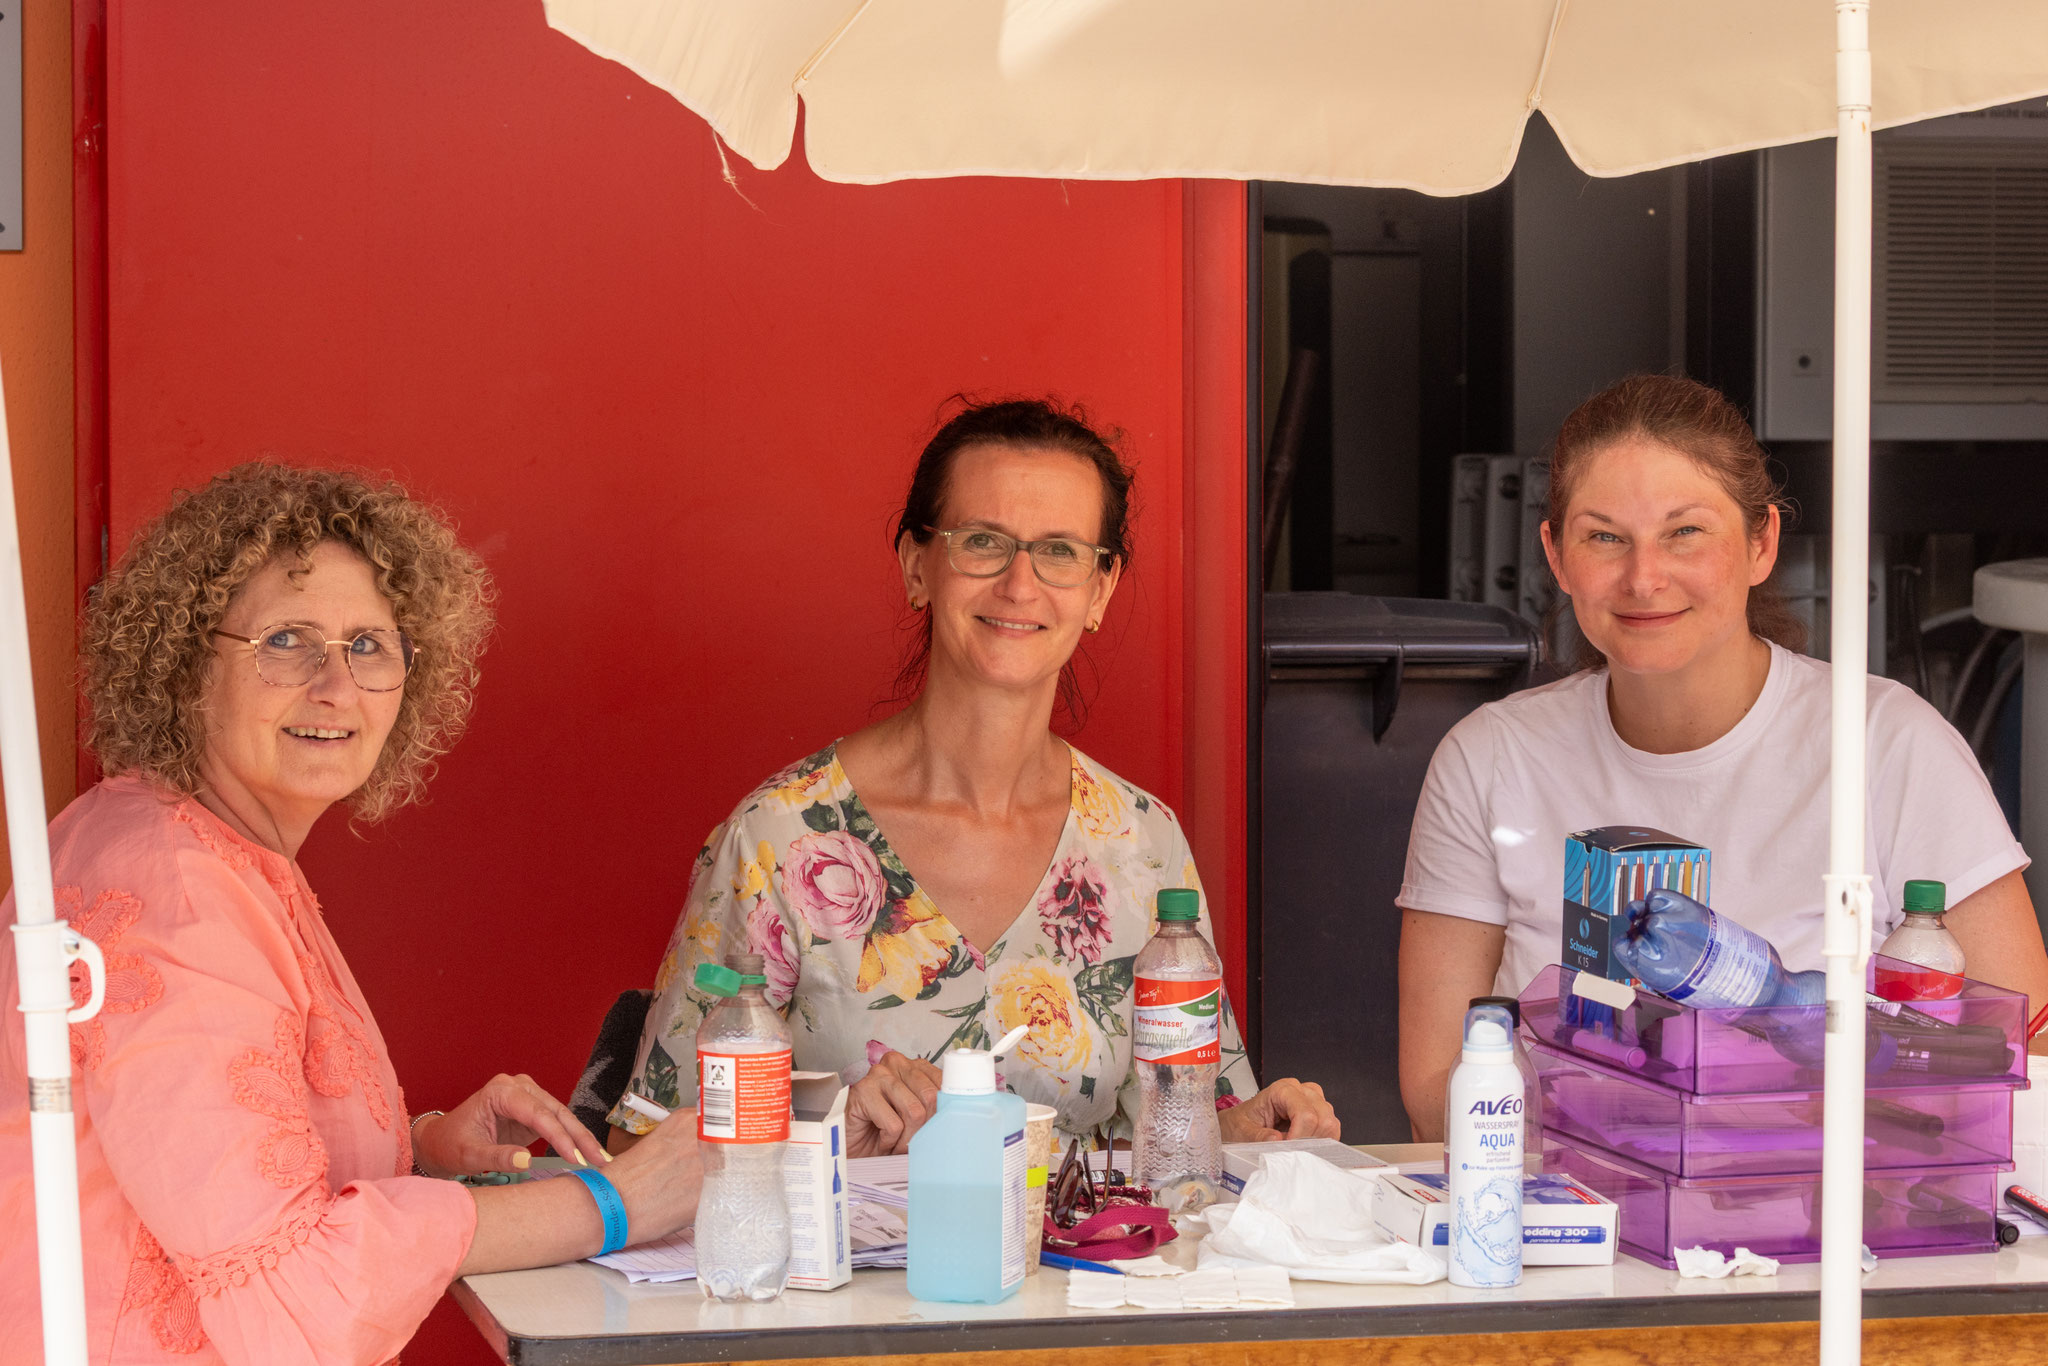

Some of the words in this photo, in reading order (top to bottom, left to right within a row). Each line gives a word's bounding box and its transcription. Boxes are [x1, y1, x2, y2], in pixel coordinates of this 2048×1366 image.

[1569, 938, 1598, 958] Schneider
[1577, 956, 1582, 966] K
[1582, 957, 1590, 968] 15
[1137, 1016, 1183, 1027] Mineralwasser
[1197, 1050, 1206, 1059] 0,5
[1468, 1094, 1523, 1116] AVEO
[1473, 1119, 1520, 1131] WASSERSPRAY
[1479, 1133, 1516, 1151] AQUA
[1524, 1228, 1562, 1239] edding
[1564, 1228, 1589, 1237] 300
